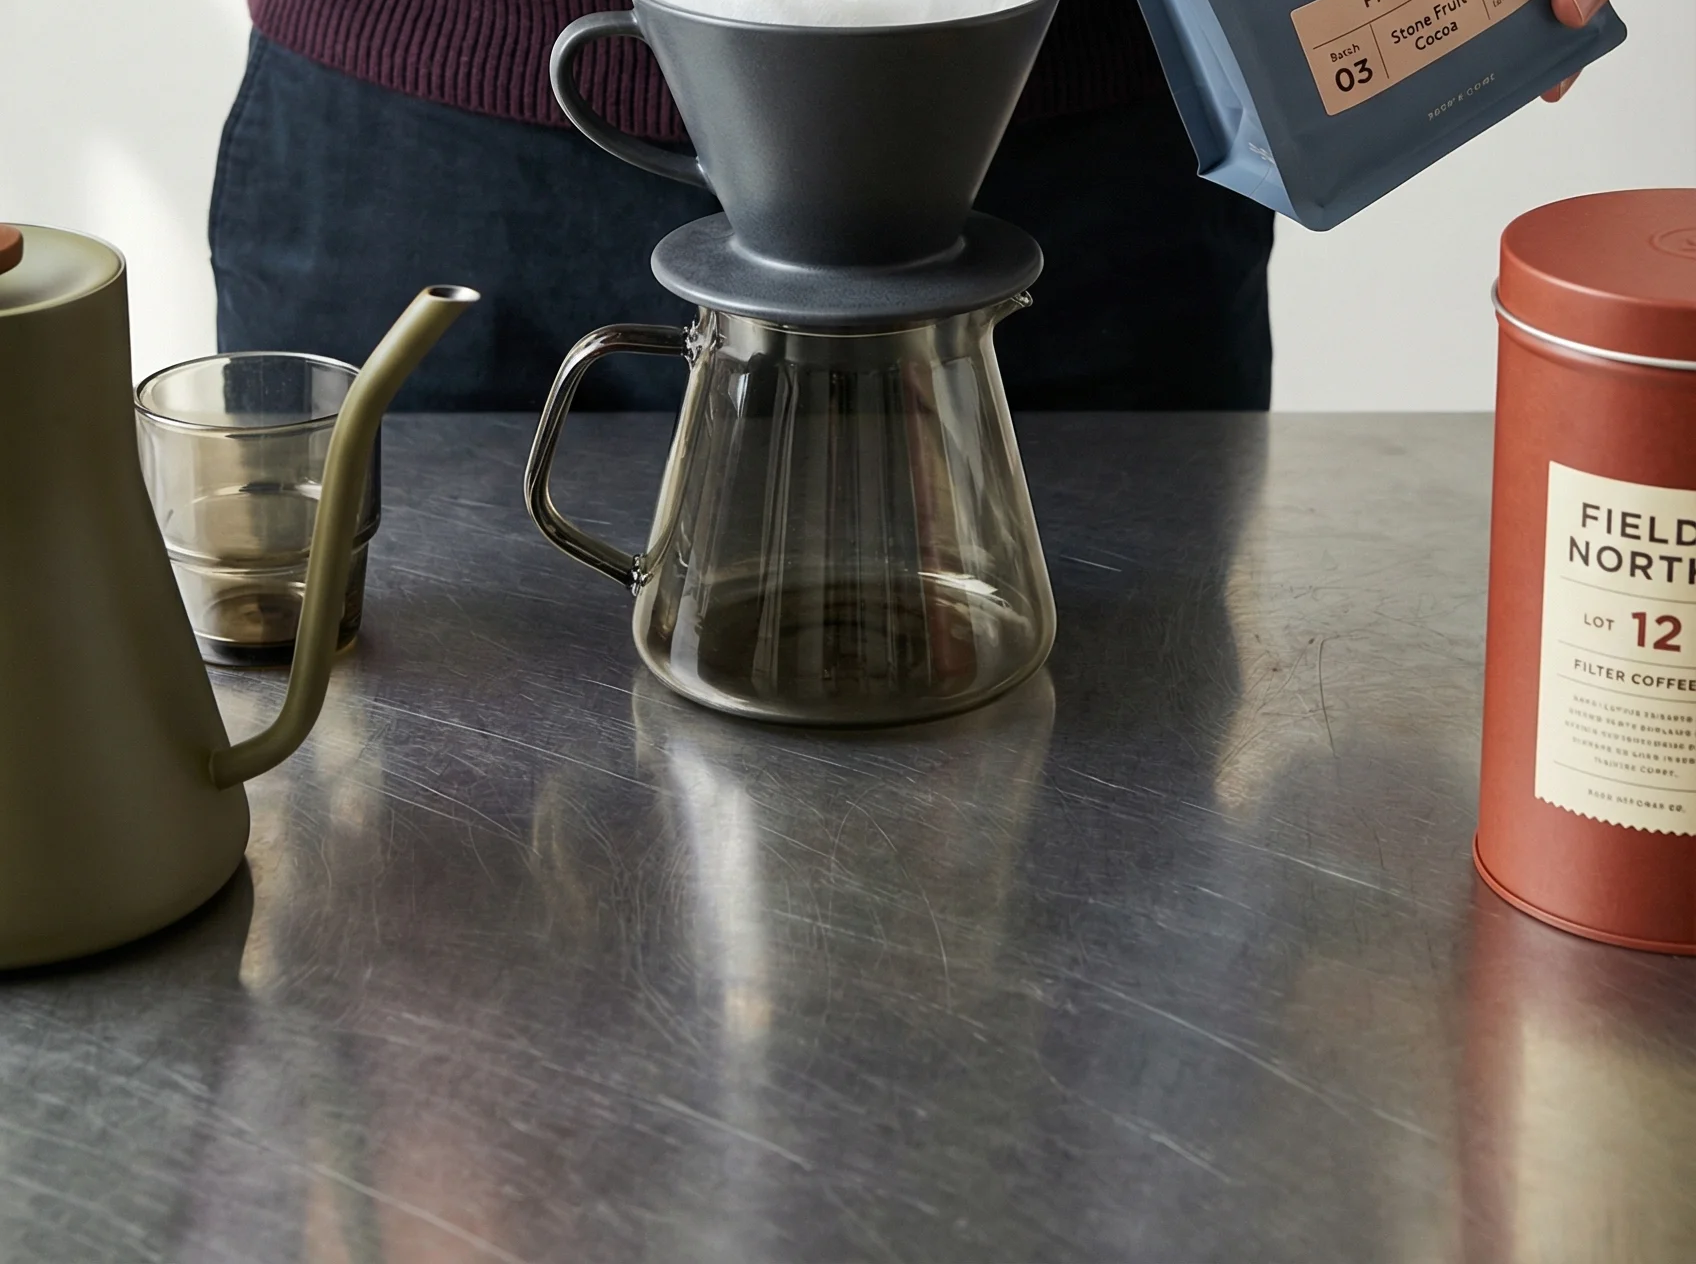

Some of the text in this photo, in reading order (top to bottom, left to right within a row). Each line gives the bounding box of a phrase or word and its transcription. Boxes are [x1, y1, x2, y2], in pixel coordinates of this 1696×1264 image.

[1390, 15, 1432, 45] Stone
[1414, 20, 1459, 51] Cocoa
[1335, 57, 1374, 93] 03
[1581, 502, 1696, 546] FIELD
[1584, 611, 1682, 653] LOT 12
[1574, 658, 1696, 692] FILTER COFFEE
